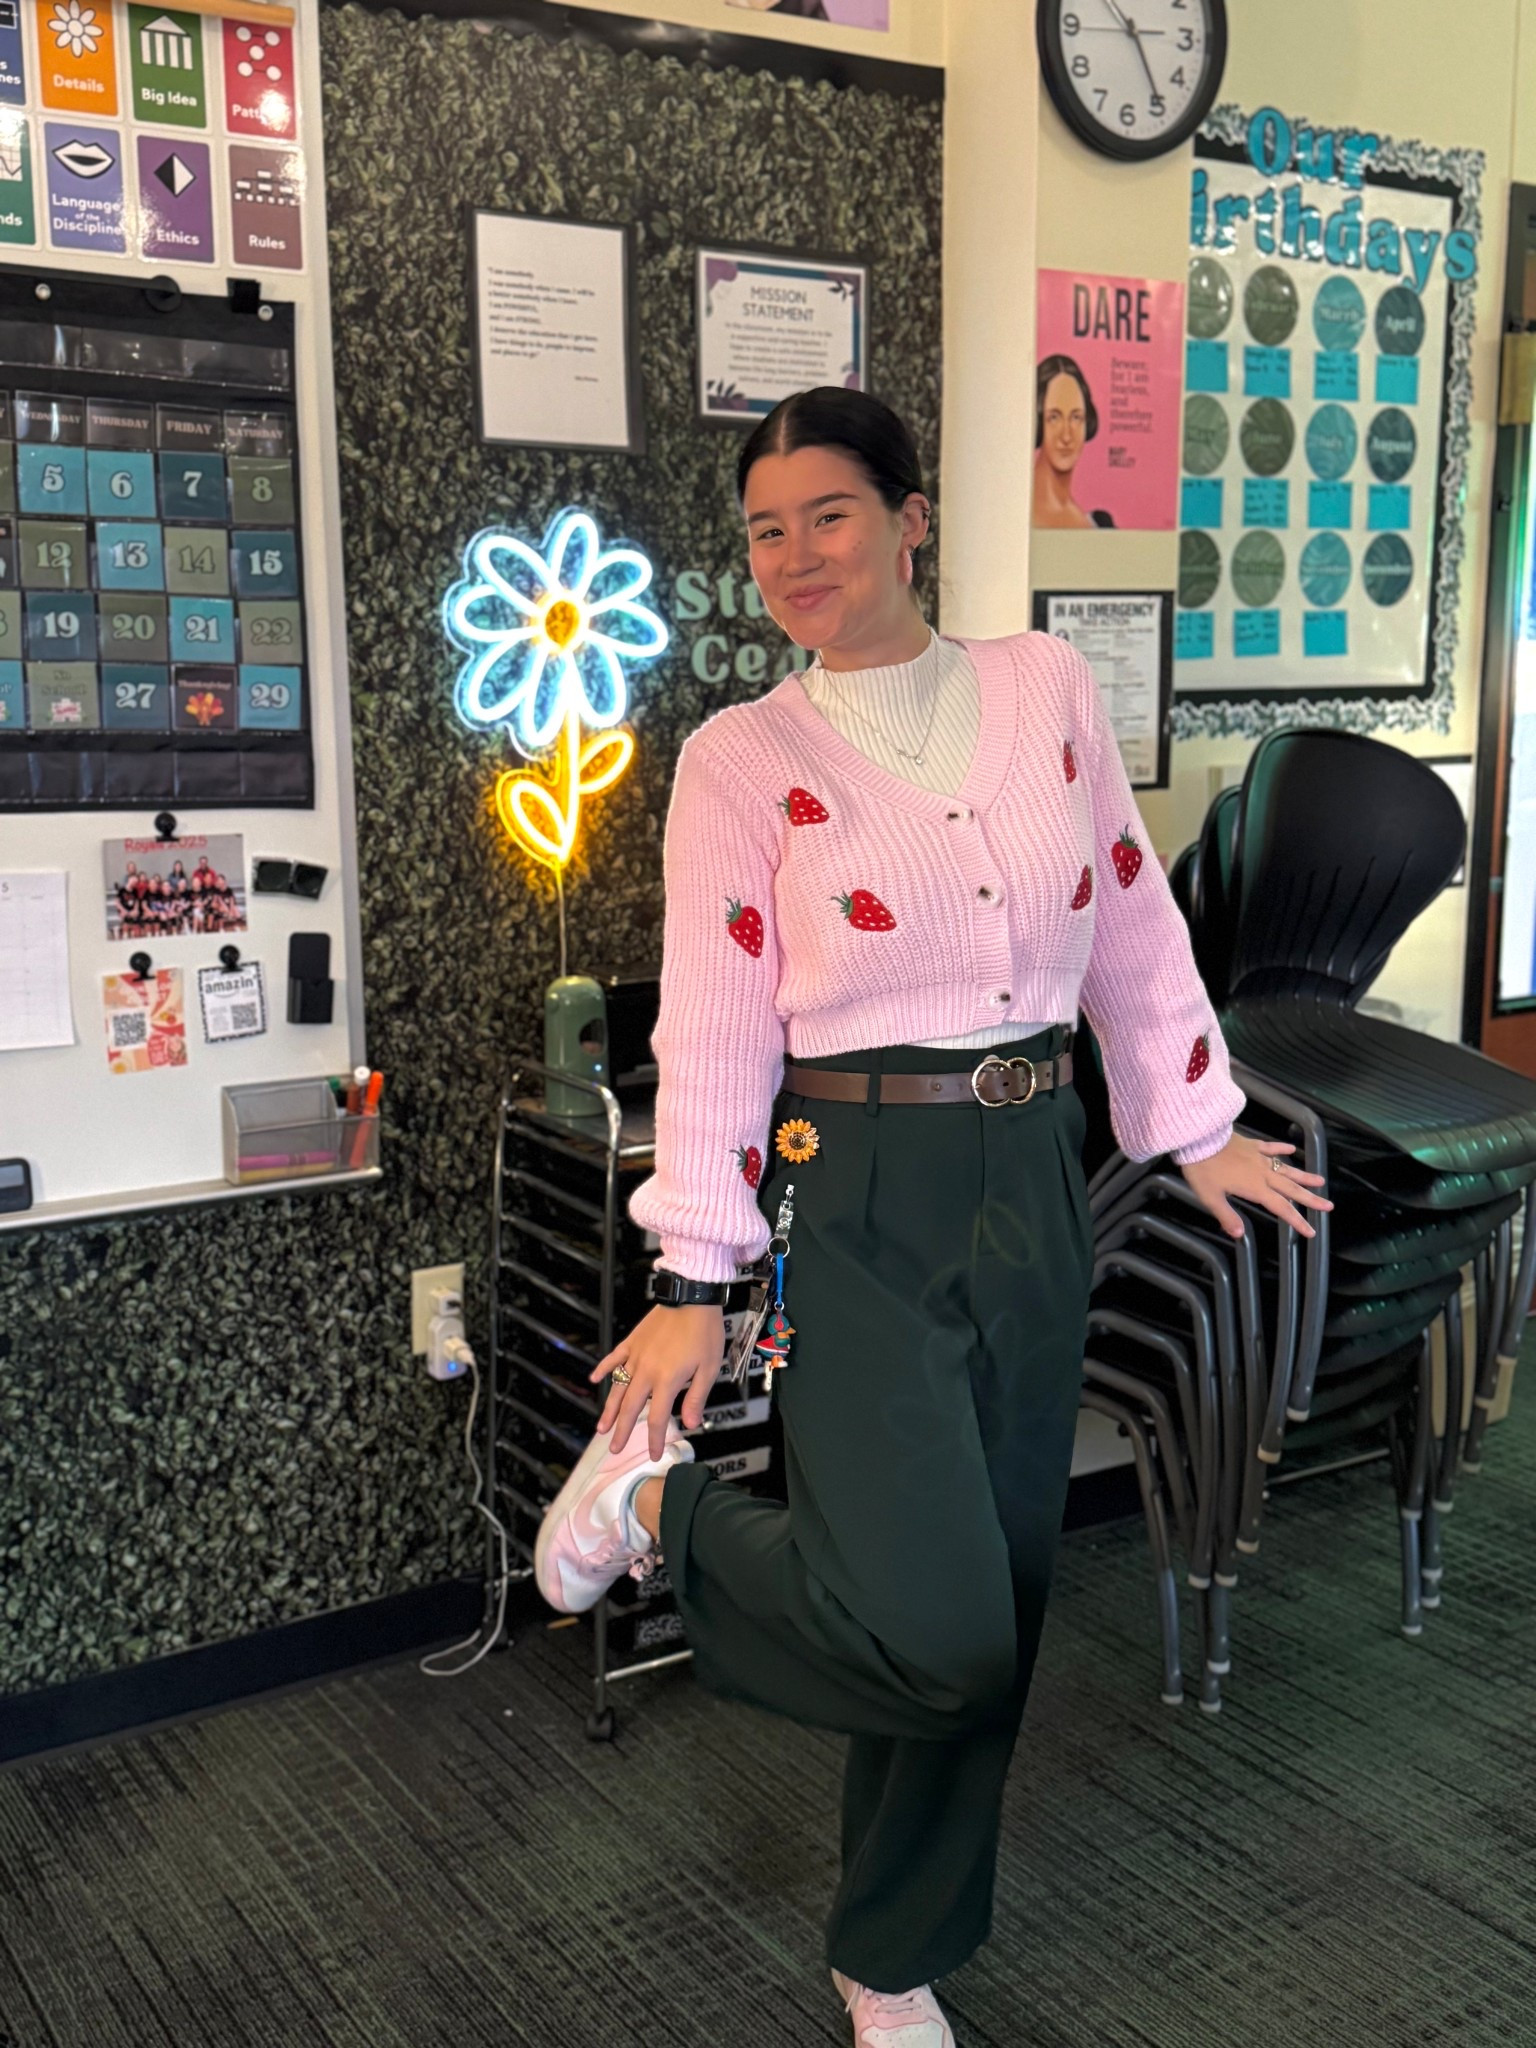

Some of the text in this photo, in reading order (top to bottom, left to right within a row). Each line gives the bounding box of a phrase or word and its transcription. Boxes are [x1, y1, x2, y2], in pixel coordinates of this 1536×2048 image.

[1063, 13, 1080, 37] 9
[1176, 27, 1194, 52] 3
[1071, 55, 1090, 78] 8
[1170, 66, 1186, 88] 4
[53, 74, 104, 93] Details
[141, 88, 198, 107] Big Idea
[1093, 88, 1108, 112] 7
[1148, 94, 1166, 117] 5
[1119, 103, 1136, 127] 6
[1246, 106, 1380, 190] Our
[52, 193, 121, 213] Language
[53, 217, 122, 236] Discipline
[75, 213, 99, 222] of the
[156, 229, 200, 246] Ethics
[249, 234, 286, 250] Rules
[1190, 169, 1478, 296] irthdays
[750, 286, 807, 304] MISSION
[742, 303, 814, 322] STATEMENT
[1073, 283, 1152, 343] DARE
[92, 415, 149, 430] THURSDAY
[166, 420, 212, 436] FRIDAY
[42, 465, 64, 492] 5
[110, 472, 133, 498] 6
[183, 471, 202, 497] 7
[252, 477, 273, 502] 8
[37, 541, 72, 568] 12
[113, 541, 148, 569] 13
[180, 546, 215, 574] 14
[250, 550, 283, 576] 15
[1054, 603, 1155, 618] IN AN EMERGENCY
[44, 611, 80, 638] 19
[112, 614, 156, 640] 20
[185, 616, 220, 643] 21
[252, 618, 292, 645] 22
[115, 682, 155, 708] 27
[251, 684, 290, 708] 29
